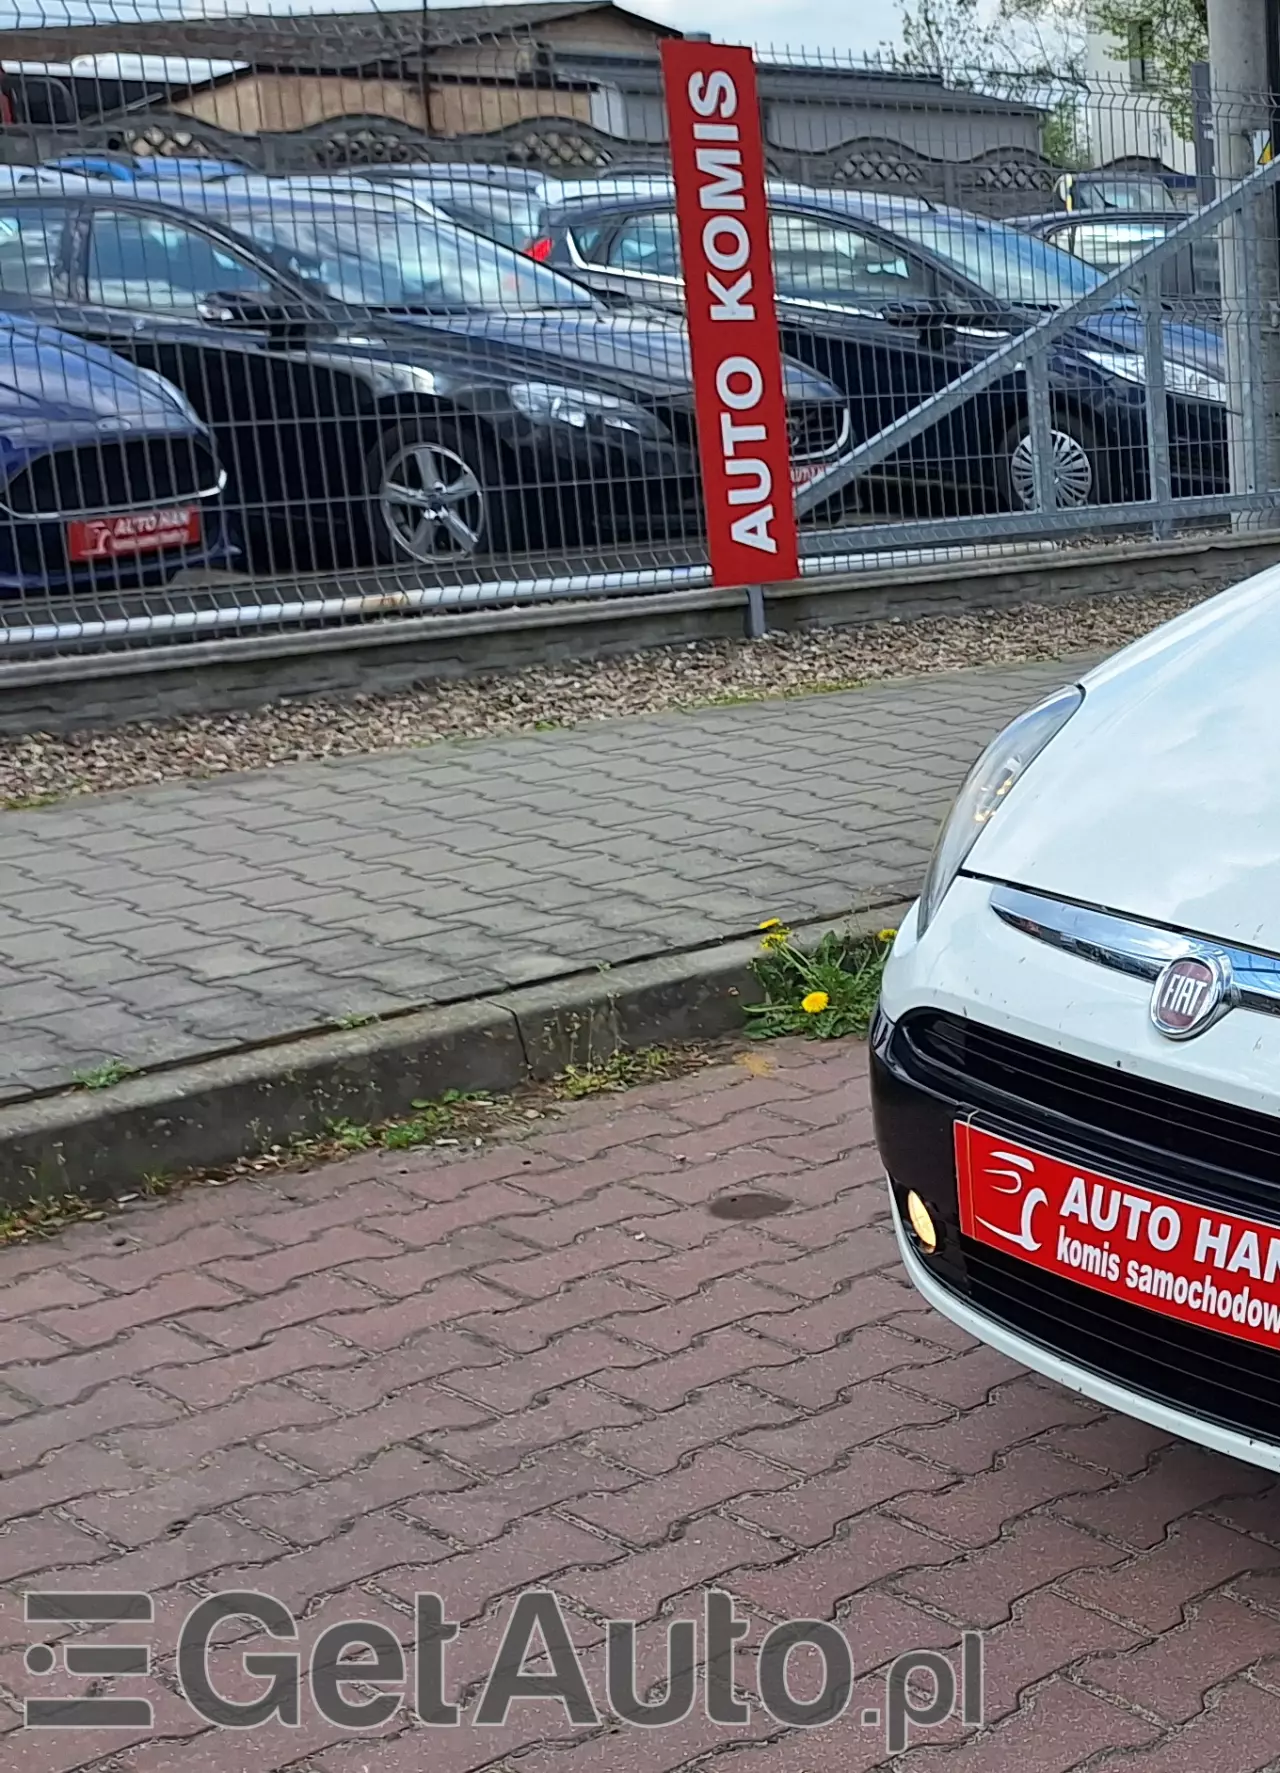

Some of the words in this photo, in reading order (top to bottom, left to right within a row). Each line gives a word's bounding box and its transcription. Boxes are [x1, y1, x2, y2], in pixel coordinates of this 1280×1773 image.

[688, 70, 755, 321] KOMIS
[716, 356, 777, 554] AUTO
[1162, 974, 1207, 1016] FIAT
[1060, 1176, 1181, 1252] AUTO
[1057, 1225, 1121, 1282] komis
